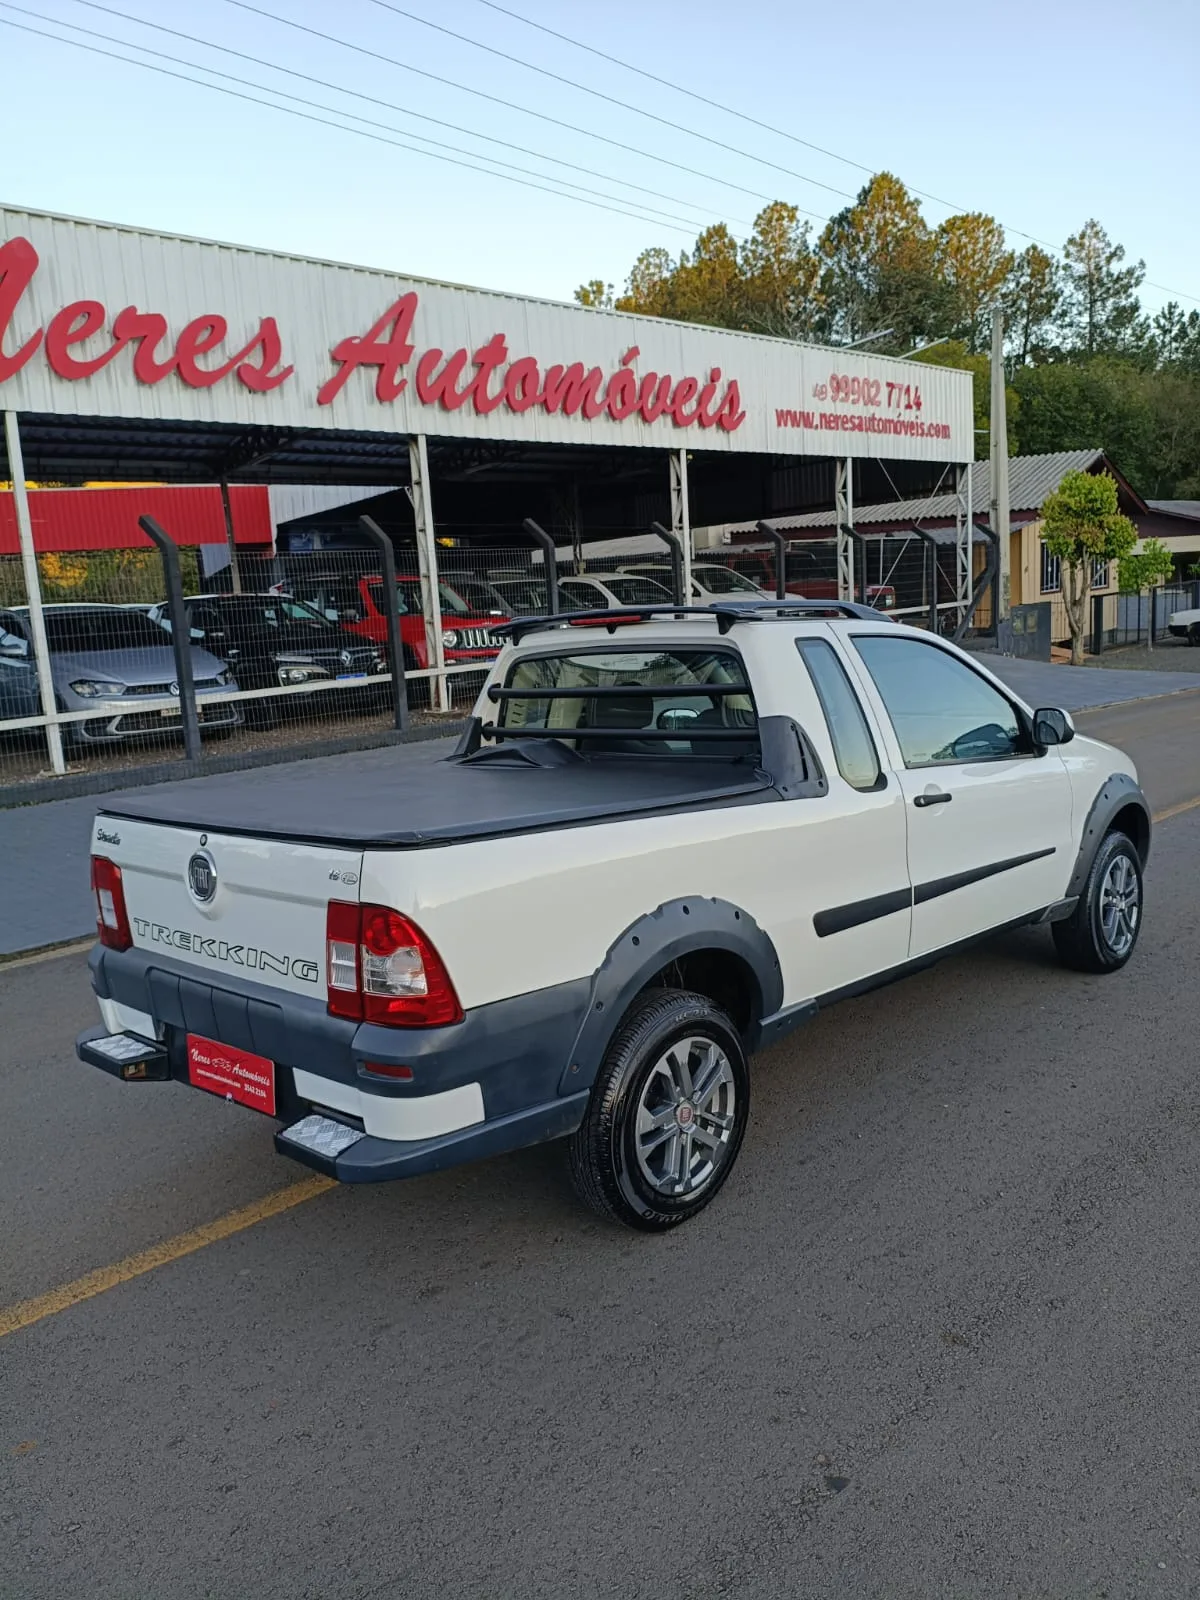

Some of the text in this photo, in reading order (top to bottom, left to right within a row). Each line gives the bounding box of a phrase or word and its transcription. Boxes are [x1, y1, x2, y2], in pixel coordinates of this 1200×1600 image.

[317, 292, 747, 432] Automóveis
[829, 373, 881, 407] 99902
[886, 381, 922, 411] 7714
[775, 409, 951, 439] www.neresautomóveis.com
[194, 866, 209, 889] FIAT
[133, 917, 319, 983] TREKKING
